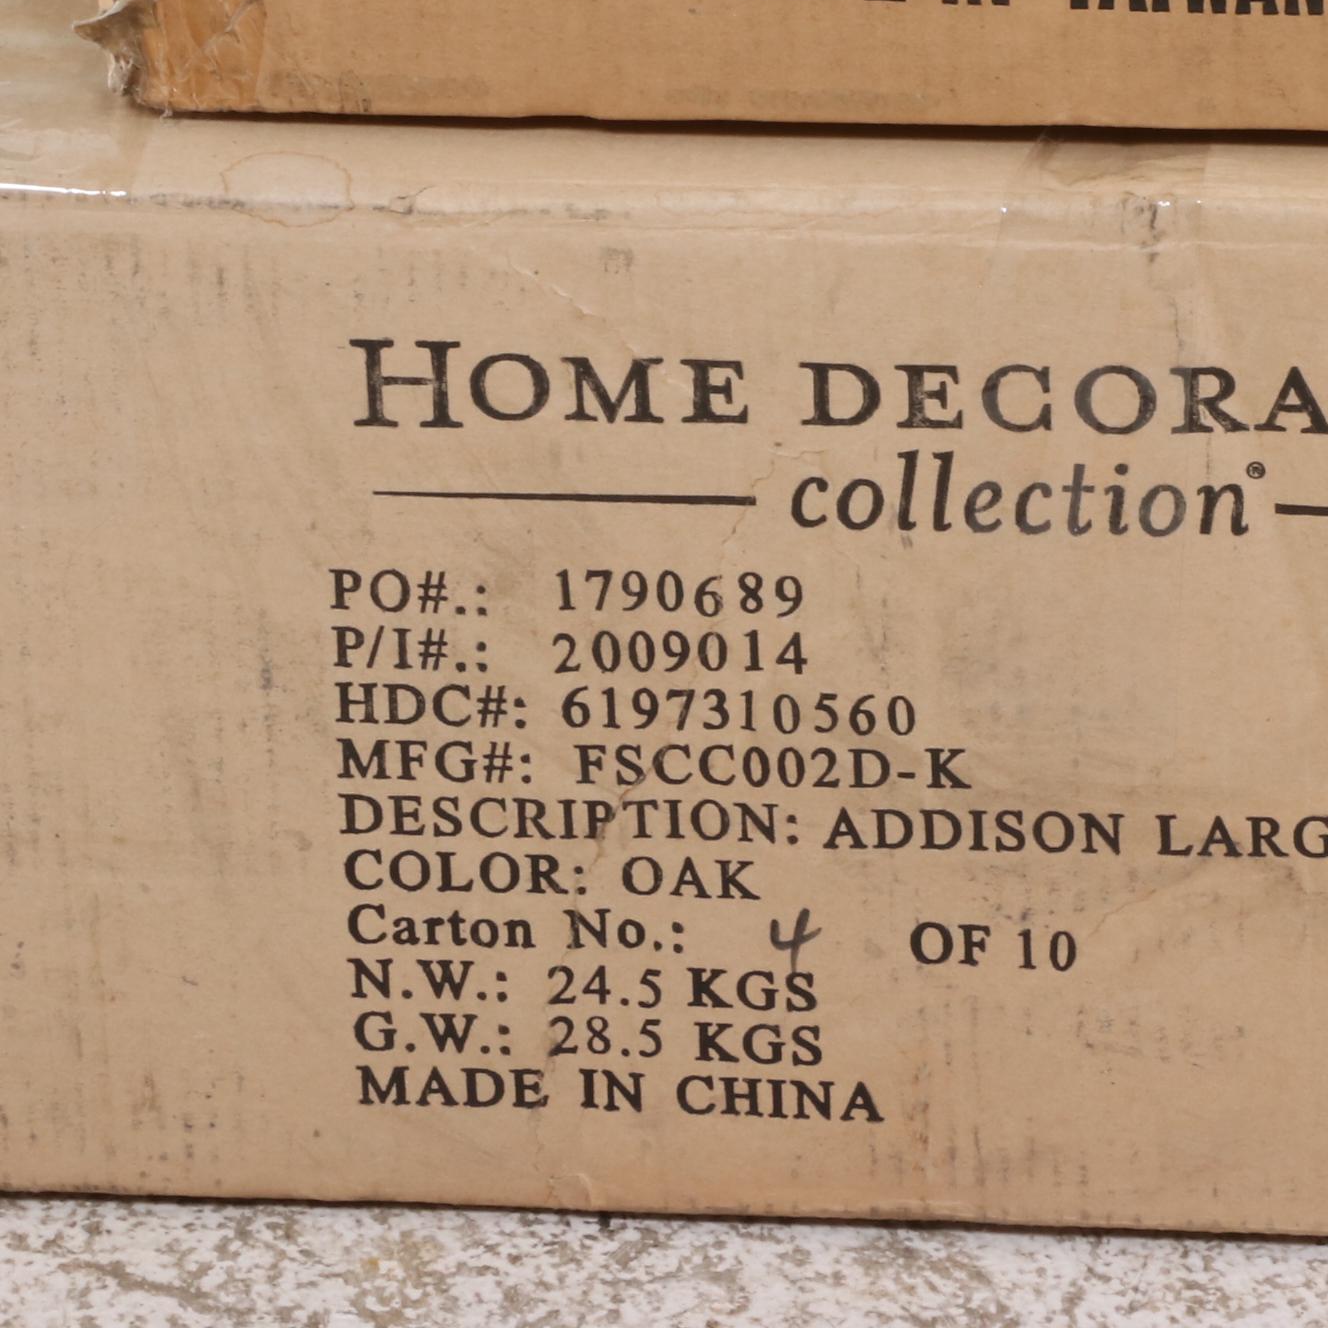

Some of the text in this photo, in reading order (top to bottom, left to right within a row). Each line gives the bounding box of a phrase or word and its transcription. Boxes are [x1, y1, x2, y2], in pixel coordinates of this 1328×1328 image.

[348, 337, 749, 429] HOME
[555, 568, 803, 618] 1790689
[552, 629, 808, 675] 2009014
[334, 681, 916, 737] HDC#: 6197310560
[335, 737, 973, 790] MFG#: FSCC002D-K
[337, 793, 799, 846] DESCRIPTION:
[822, 806, 1126, 856] ADDISON
[343, 848, 761, 901] COLOR: OAK
[347, 903, 1077, 972] Carton No.: 4 OF 10
[346, 957, 819, 1014] N.W.: 24.5 KGS
[353, 1010, 823, 1067] G.W.: 28.5 KGS
[355, 1064, 885, 1124] MADE IN CHINA
